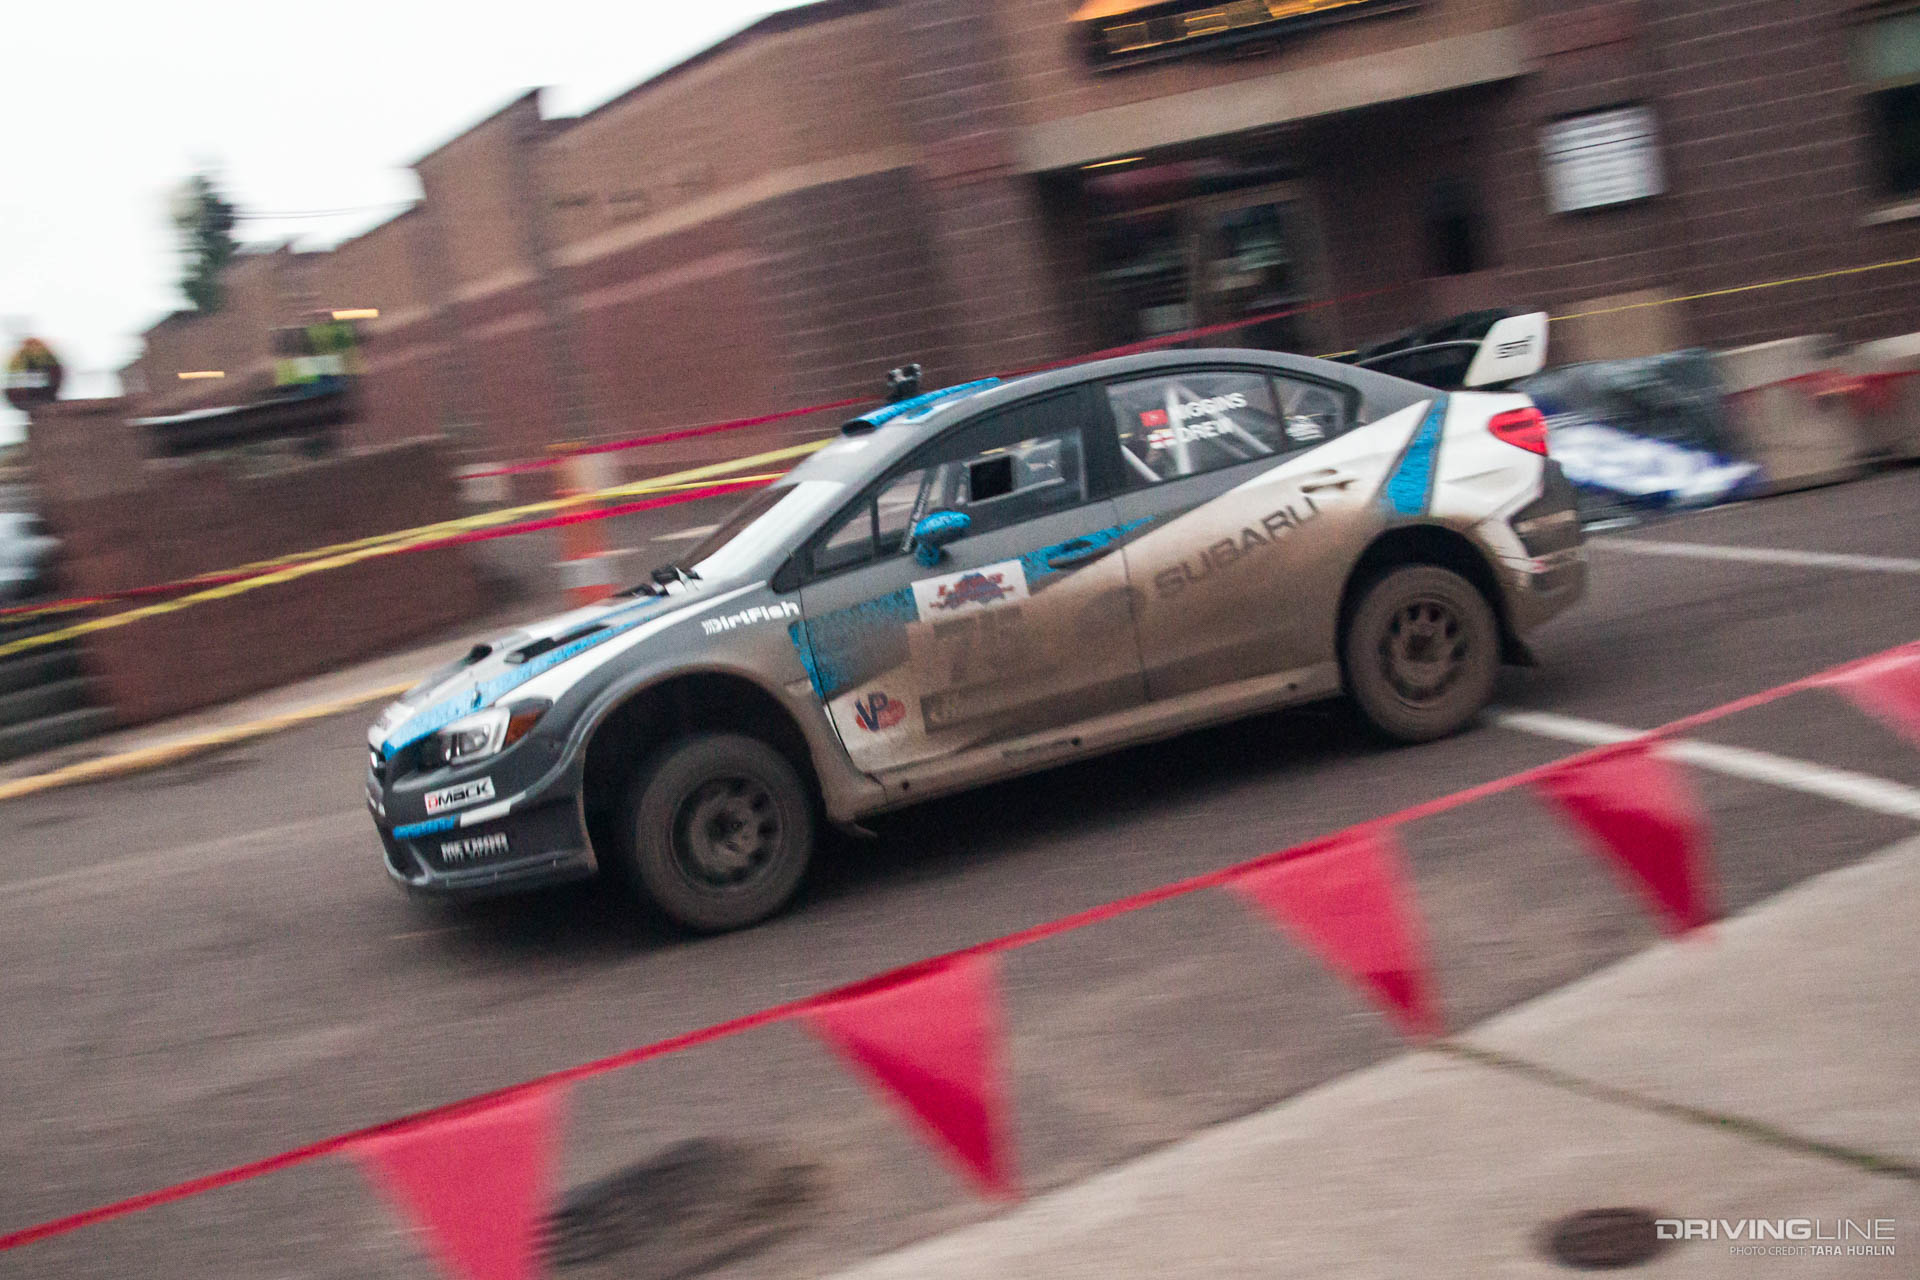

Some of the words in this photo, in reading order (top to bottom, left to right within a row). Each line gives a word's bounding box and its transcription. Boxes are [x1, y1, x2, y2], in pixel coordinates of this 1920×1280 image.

[1154, 496, 1321, 597] SUBARU
[701, 601, 800, 635] DirtFish
[854, 690, 889, 732] VP
